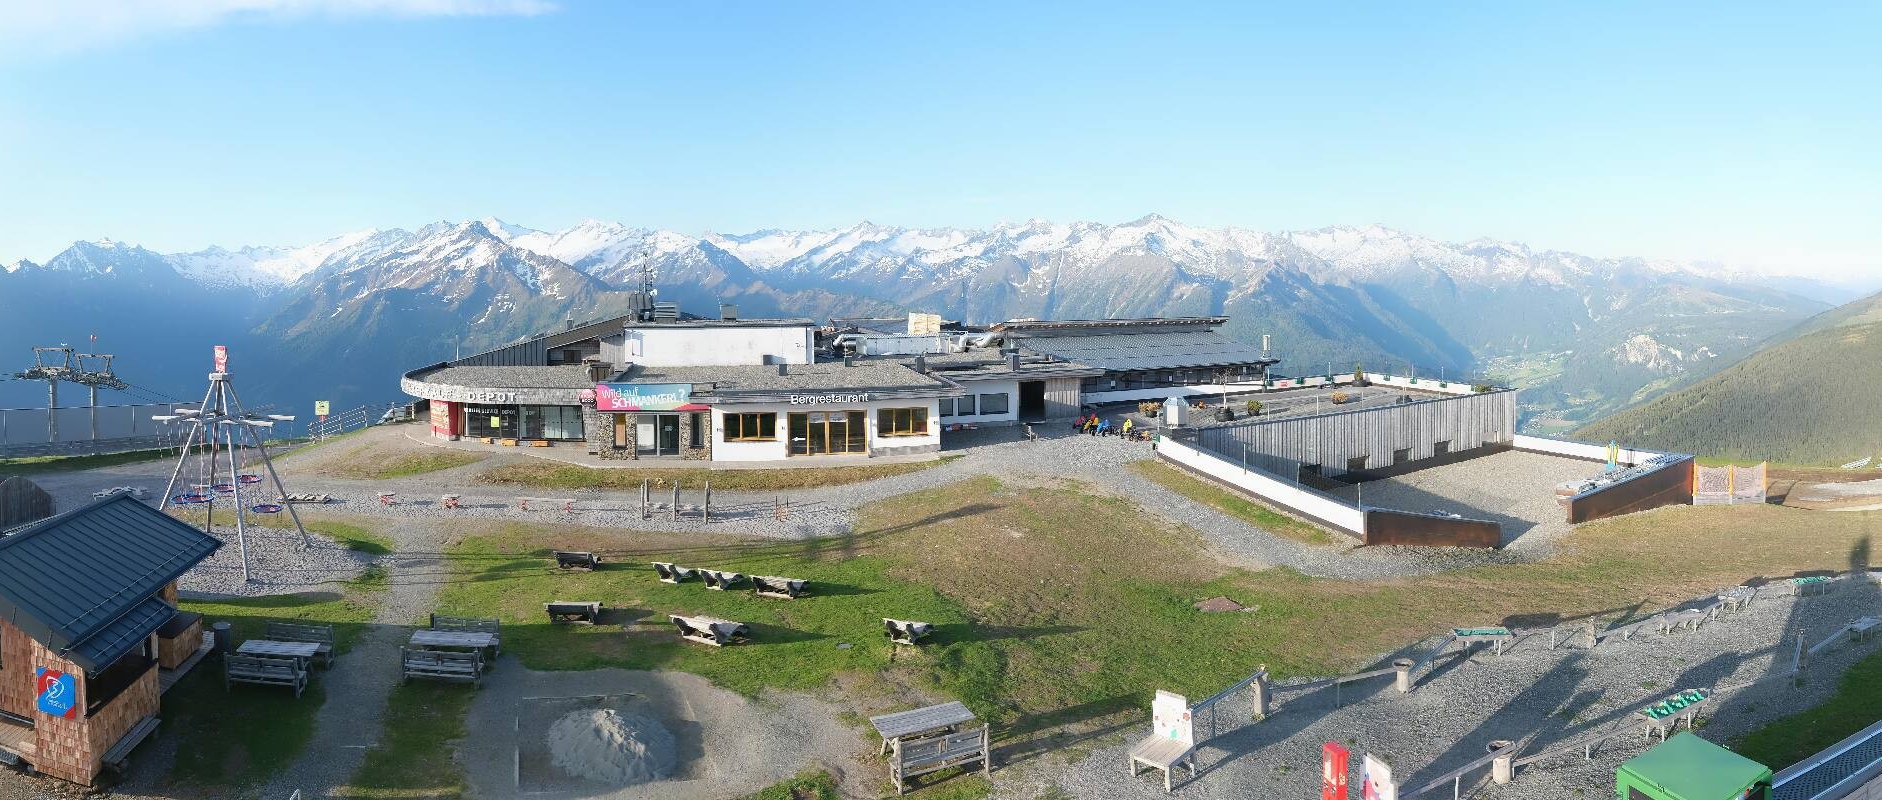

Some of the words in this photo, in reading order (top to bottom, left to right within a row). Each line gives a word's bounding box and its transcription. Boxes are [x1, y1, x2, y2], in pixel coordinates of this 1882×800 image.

[467, 391, 516, 402] DEPOT
[601, 387, 622, 399] Wild
[623, 386, 639, 397] auf
[790, 393, 869, 405] Bergrestaurant
